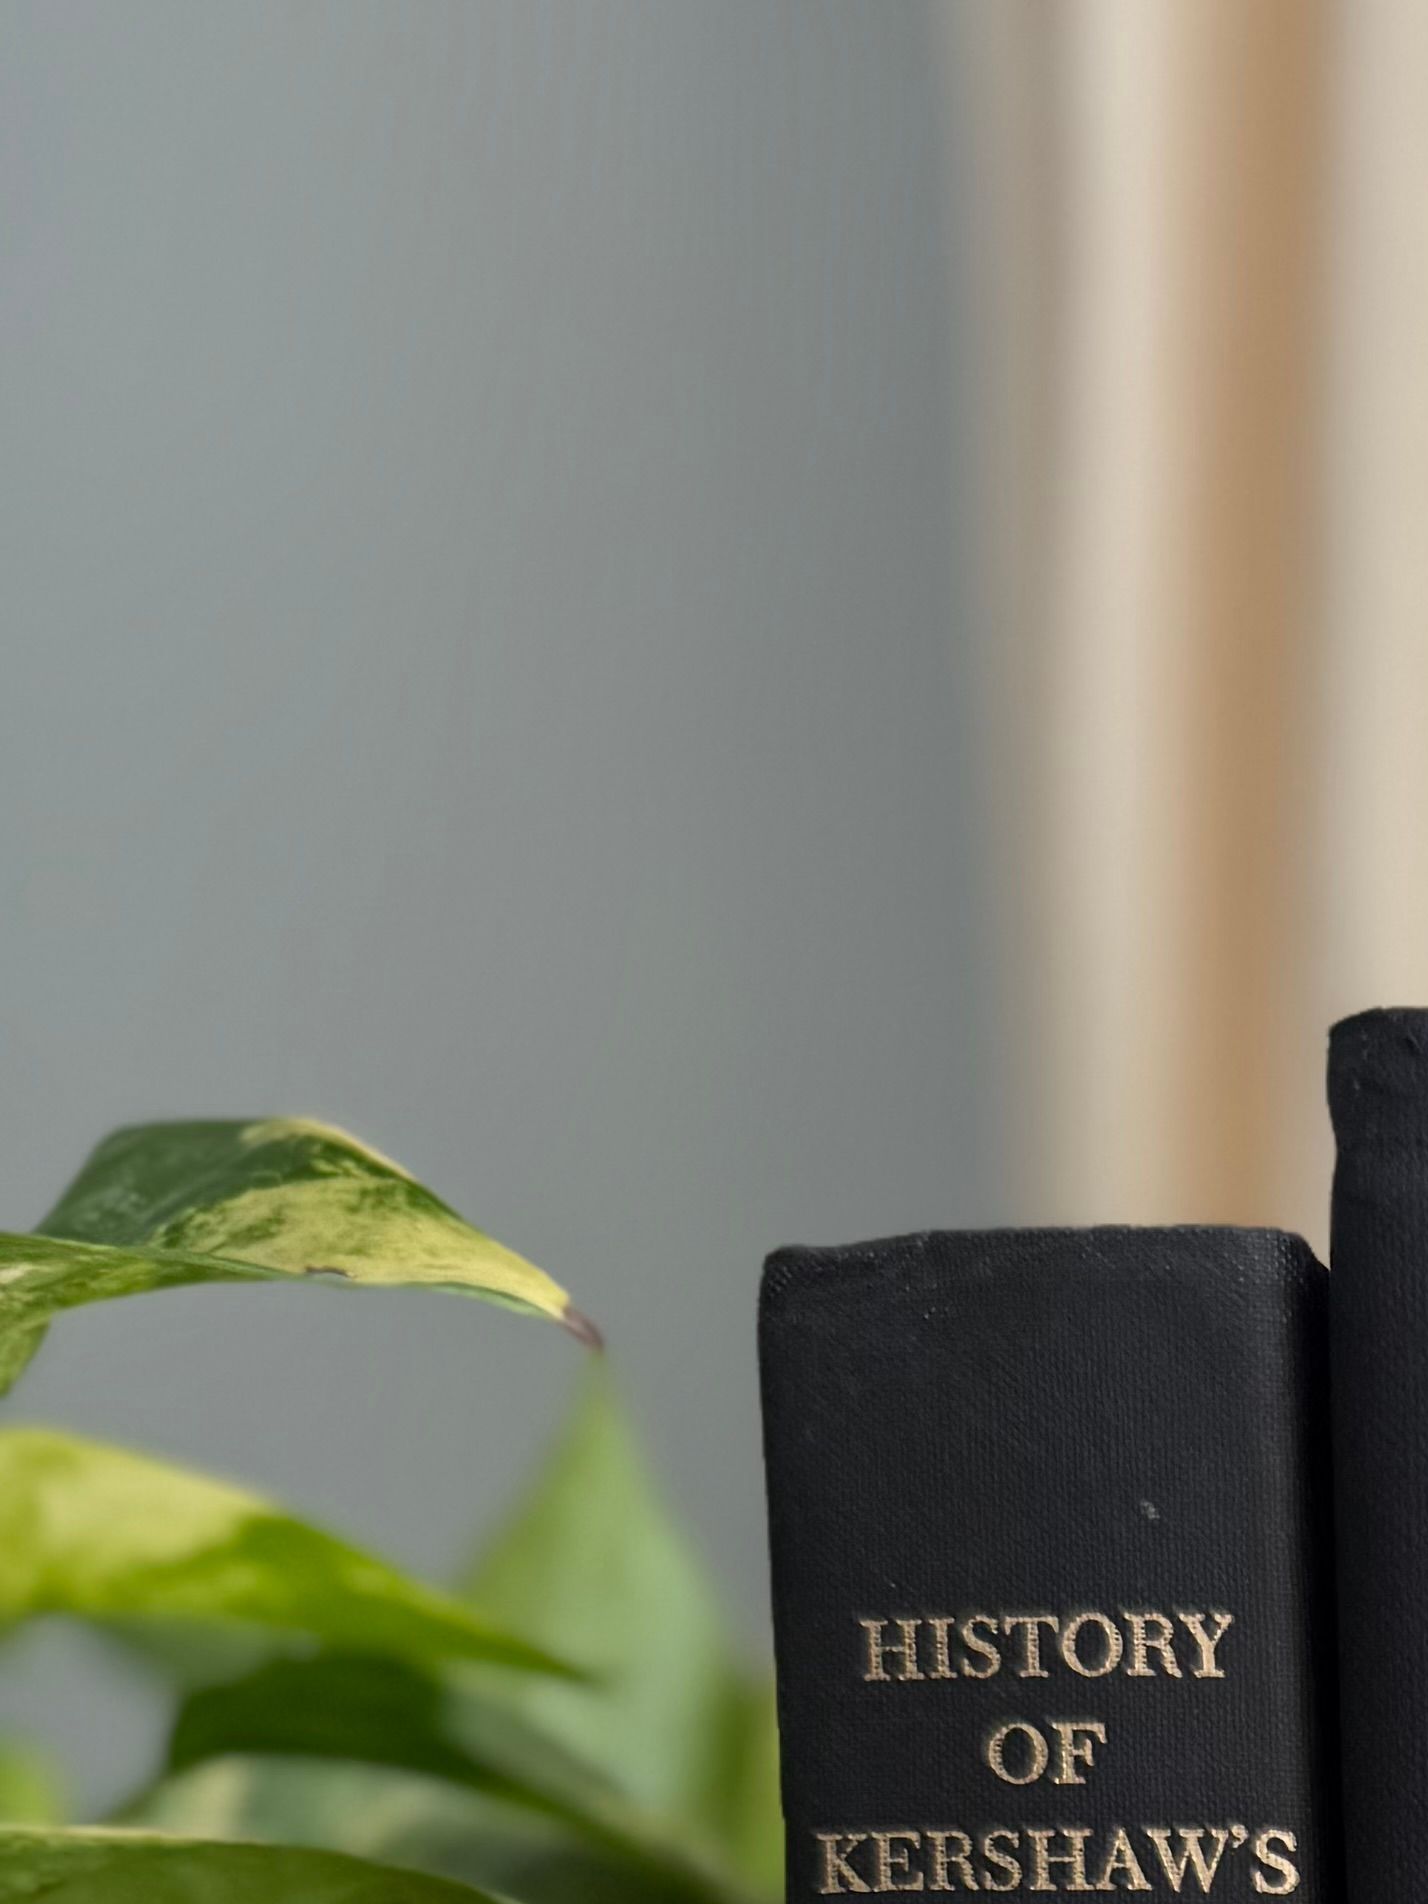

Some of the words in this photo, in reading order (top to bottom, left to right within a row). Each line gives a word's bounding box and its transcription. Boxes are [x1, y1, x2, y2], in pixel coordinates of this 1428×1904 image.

[860, 1611, 1233, 1681] HISTORY
[987, 1721, 1107, 1785] OF
[818, 1824, 1300, 1895] KERSHAW'S
